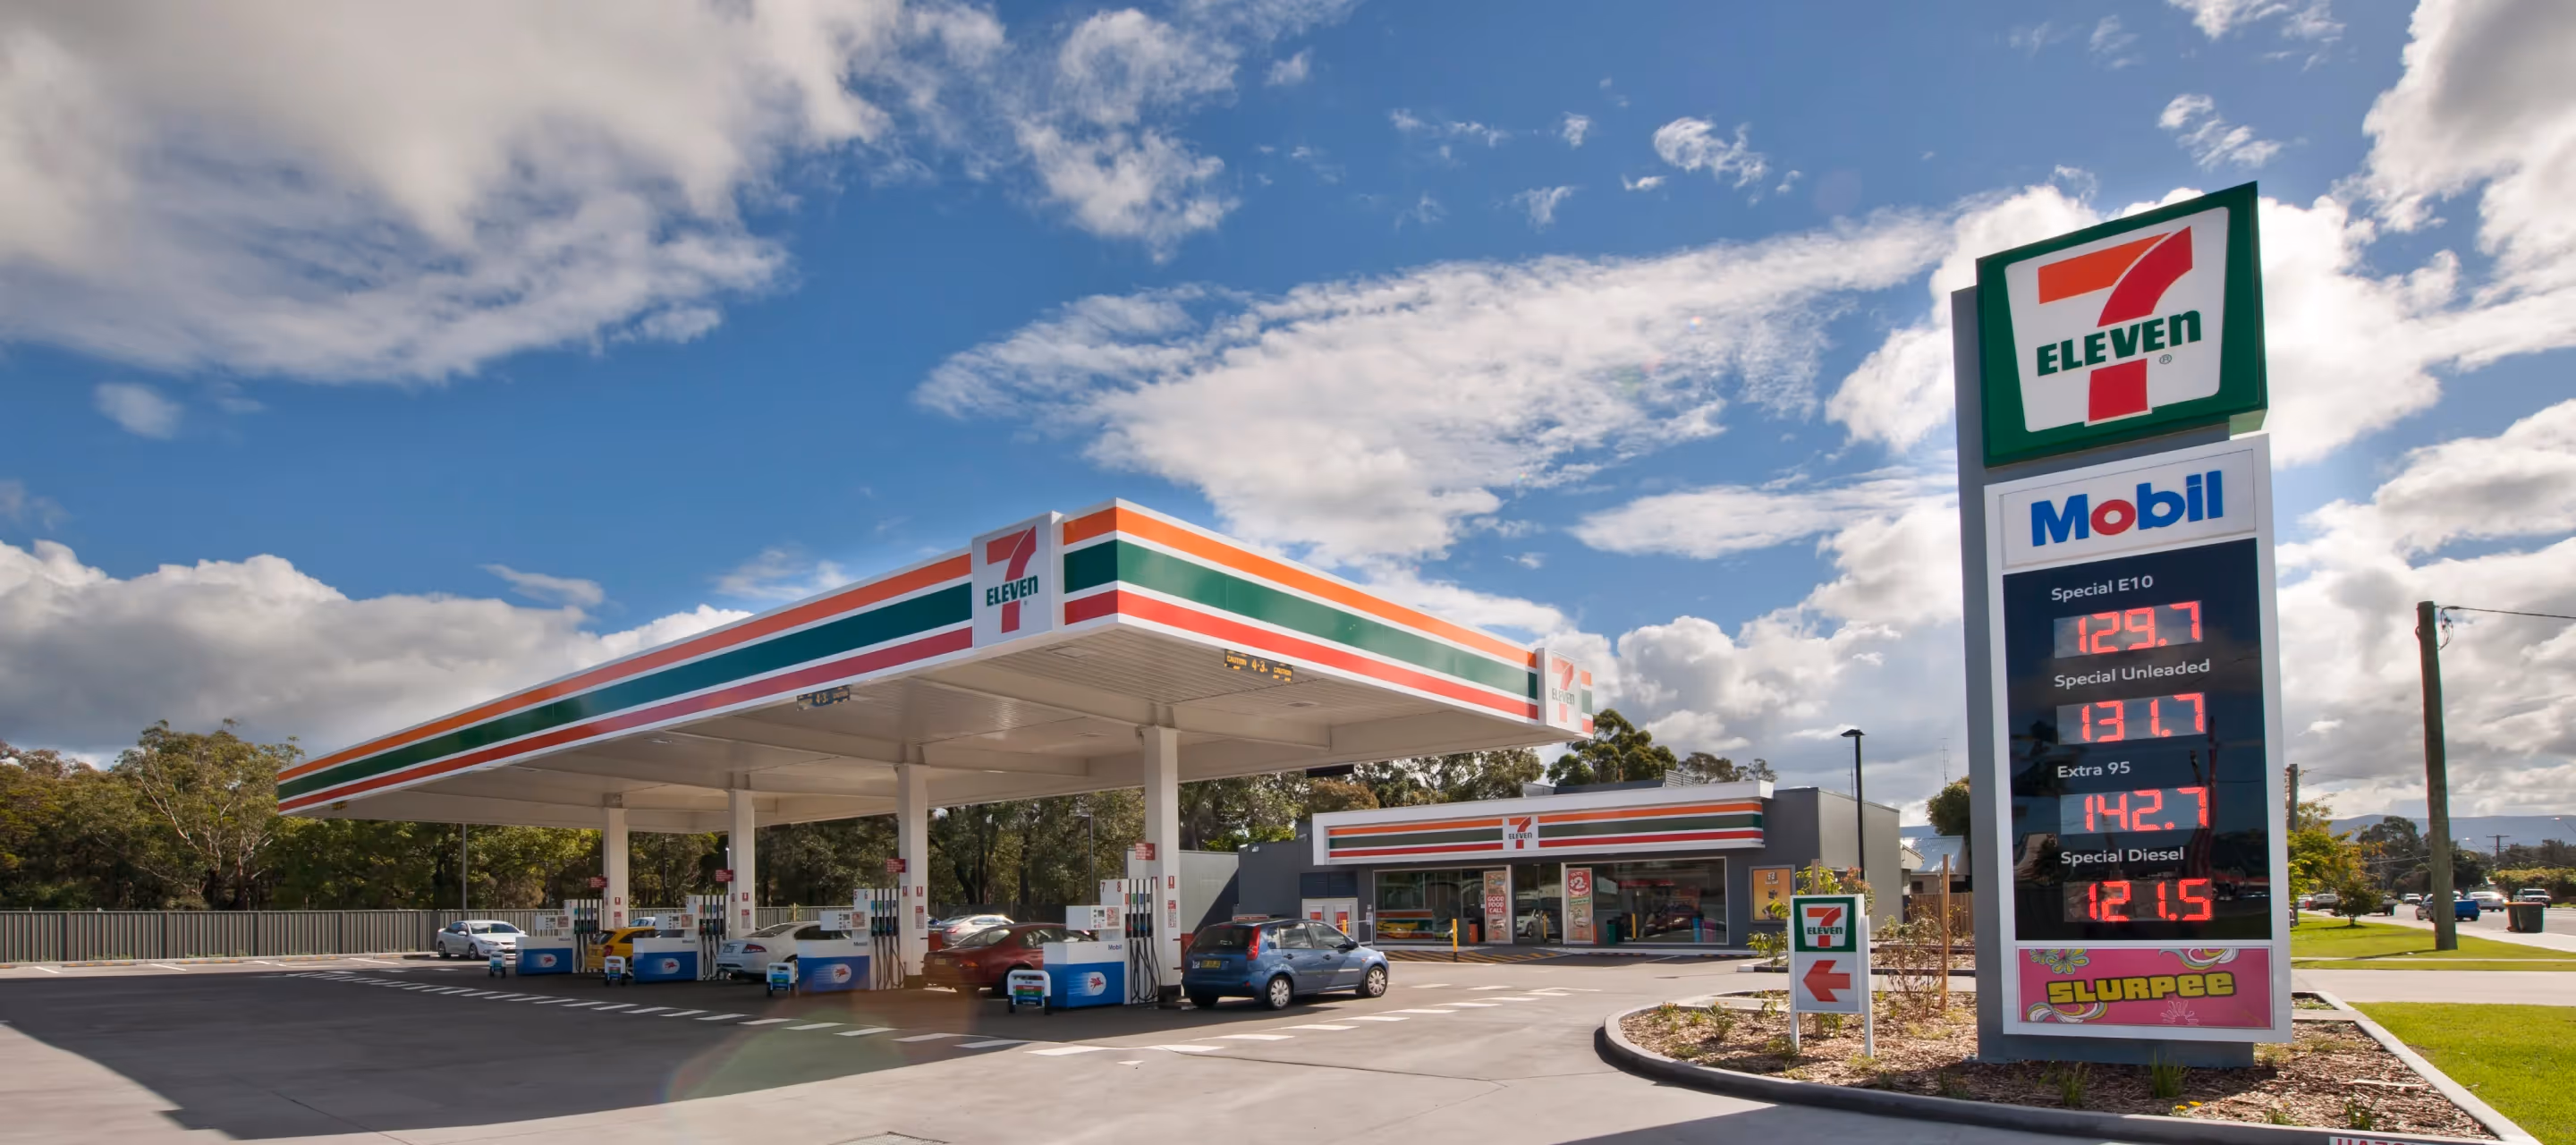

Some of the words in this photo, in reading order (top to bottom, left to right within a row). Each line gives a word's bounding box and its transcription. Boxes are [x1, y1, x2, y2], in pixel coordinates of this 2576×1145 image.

[2038, 225, 2193, 422] 7
[2031, 471, 2224, 547] Mobil
[986, 524, 1037, 634] 7
[2051, 581, 2113, 603] Special
[2118, 575, 2154, 592] E10
[2078, 600, 2201, 654] 129.7
[1552, 657, 1573, 723] 7
[2055, 669, 2116, 690] Special
[2122, 658, 2211, 681] Unleaded
[2081, 692, 2205, 742] 131.7
[2057, 764, 2103, 778] Extra
[2107, 761, 2131, 775] 95
[2085, 786, 2208, 832] 142.7
[1509, 816, 1531, 849] 7
[2061, 850, 2123, 867] Special
[2128, 847, 2184, 862] Diesel
[1101, 882, 1106, 893] 7
[1116, 881, 1122, 893] 8
[2089, 878, 2212, 921] 121.5
[1807, 907, 1842, 947] 7
